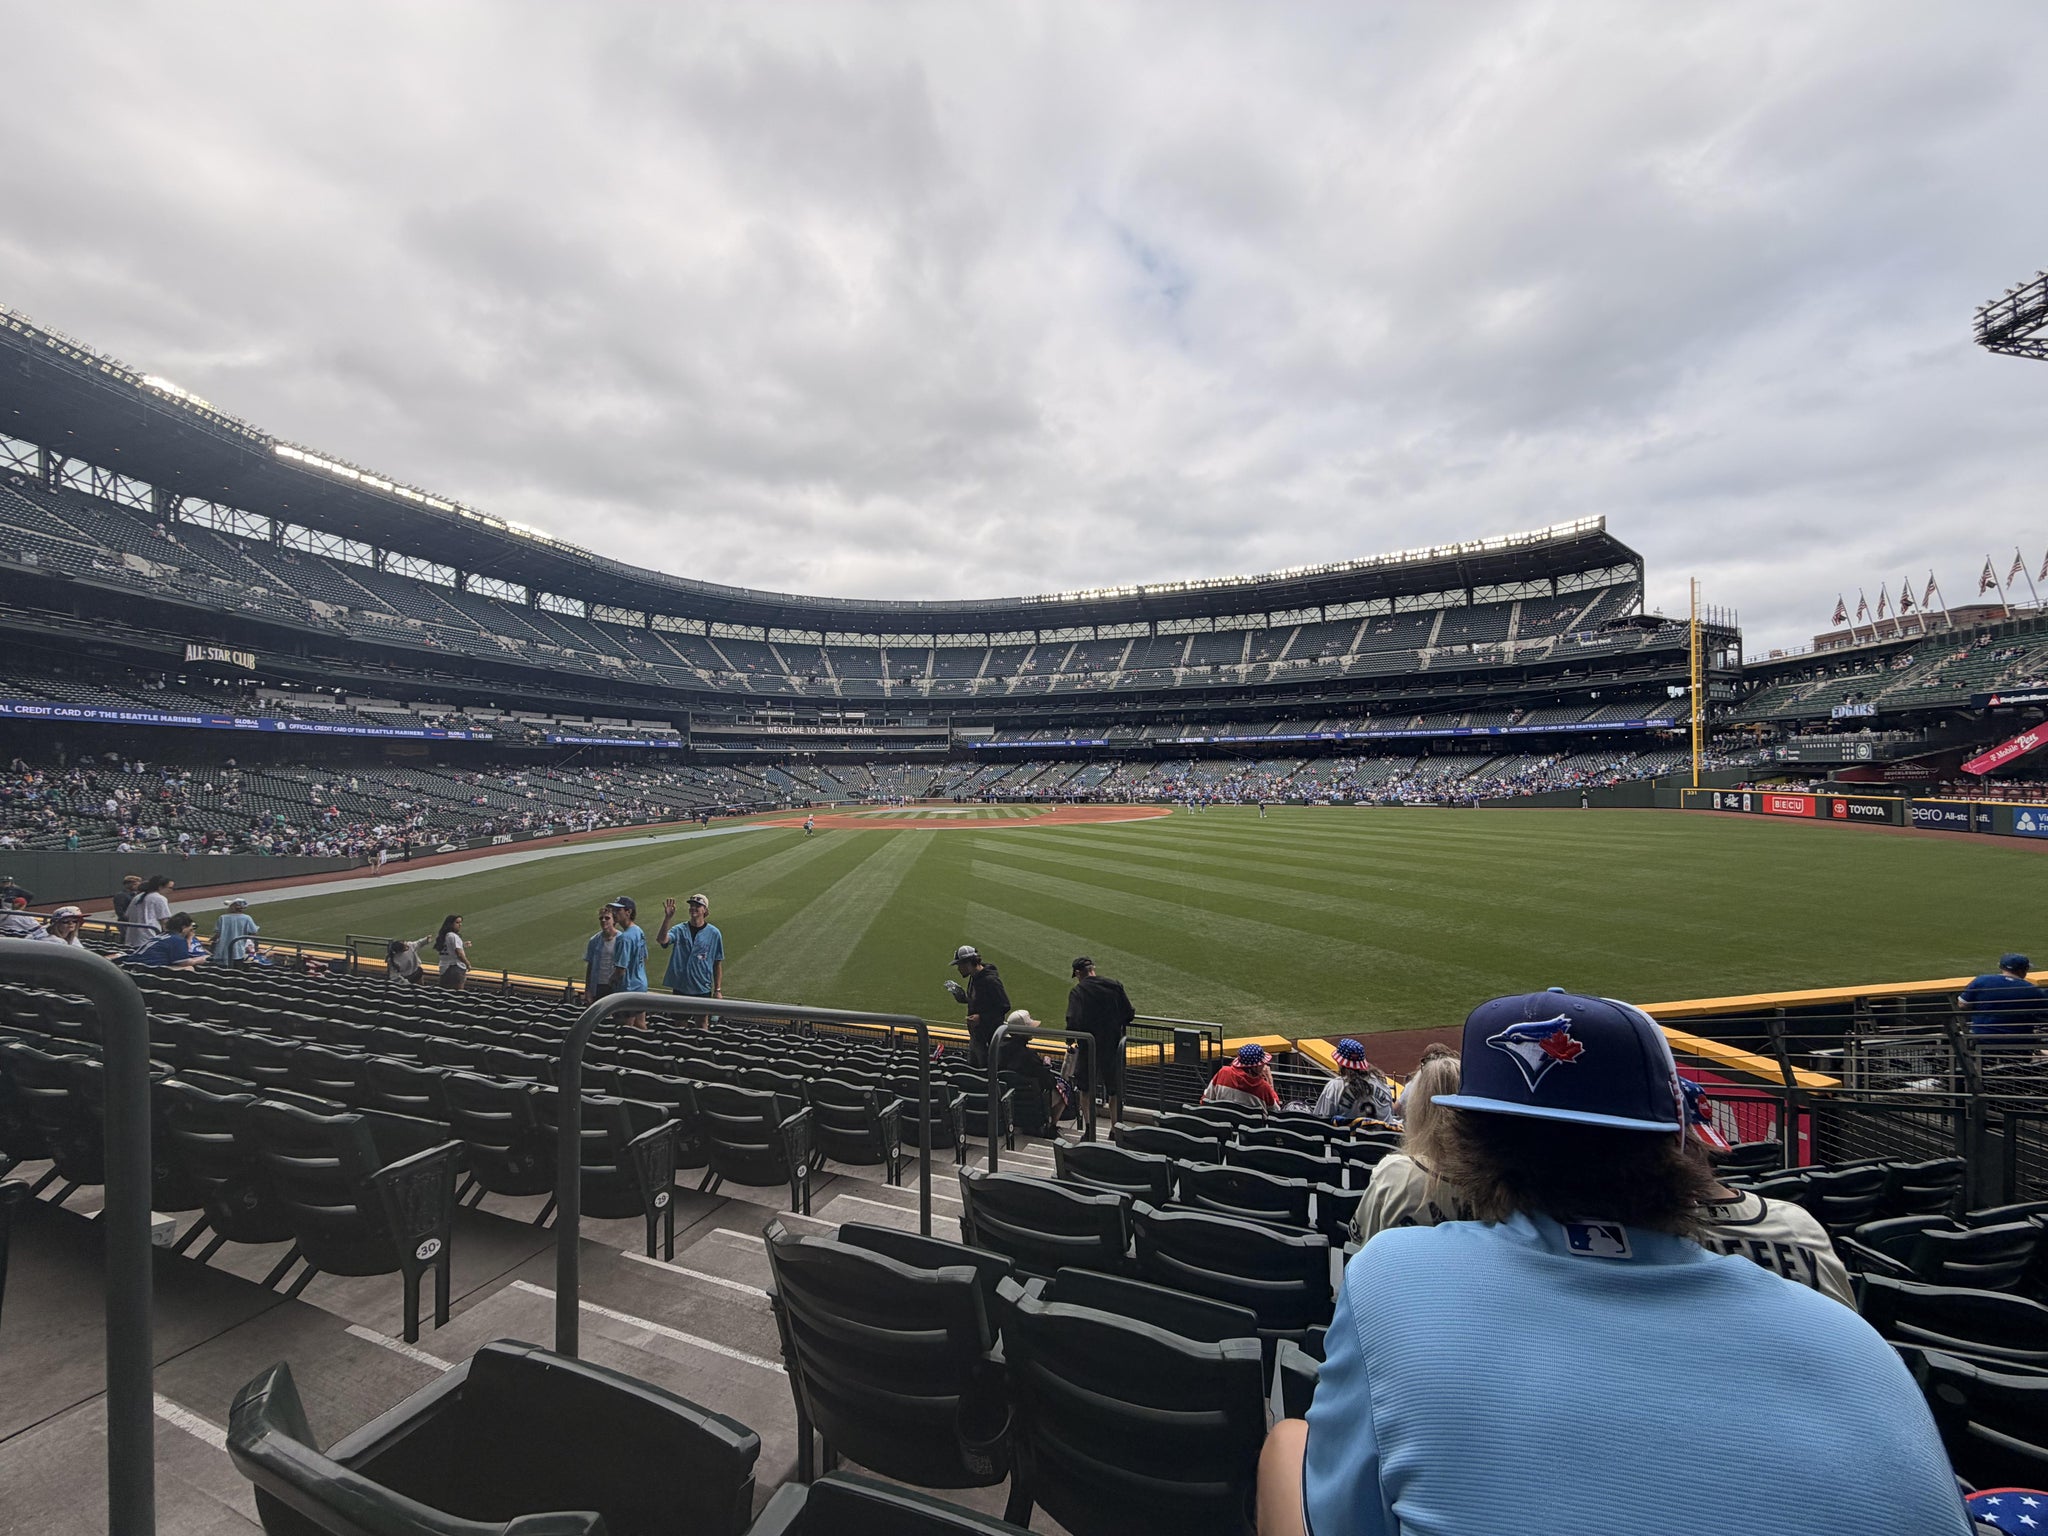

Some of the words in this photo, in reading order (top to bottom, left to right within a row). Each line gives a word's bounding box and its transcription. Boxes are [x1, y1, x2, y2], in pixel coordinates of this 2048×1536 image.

[233, 651, 256, 670] CLUB
[14, 705, 52, 715] CREDIT
[54, 708, 81, 717] CARD
[83, 709, 97, 718] OF
[99, 711, 117, 719] THE
[120, 712, 158, 721] SEATTLE
[160, 714, 202, 724] MARINERS
[289, 723, 314, 731] OFFICIAL
[314, 724, 333, 732] CREDIT
[767, 726, 805, 734] WELCOME
[819, 726, 853, 735] T-MOBILE
[854, 727, 874, 735] PARK
[1774, 800, 1801, 810] BECU
[1848, 804, 1885, 817] TOYOTA
[1912, 807, 1943, 821] eero
[492, 834, 513, 845] STIHL
